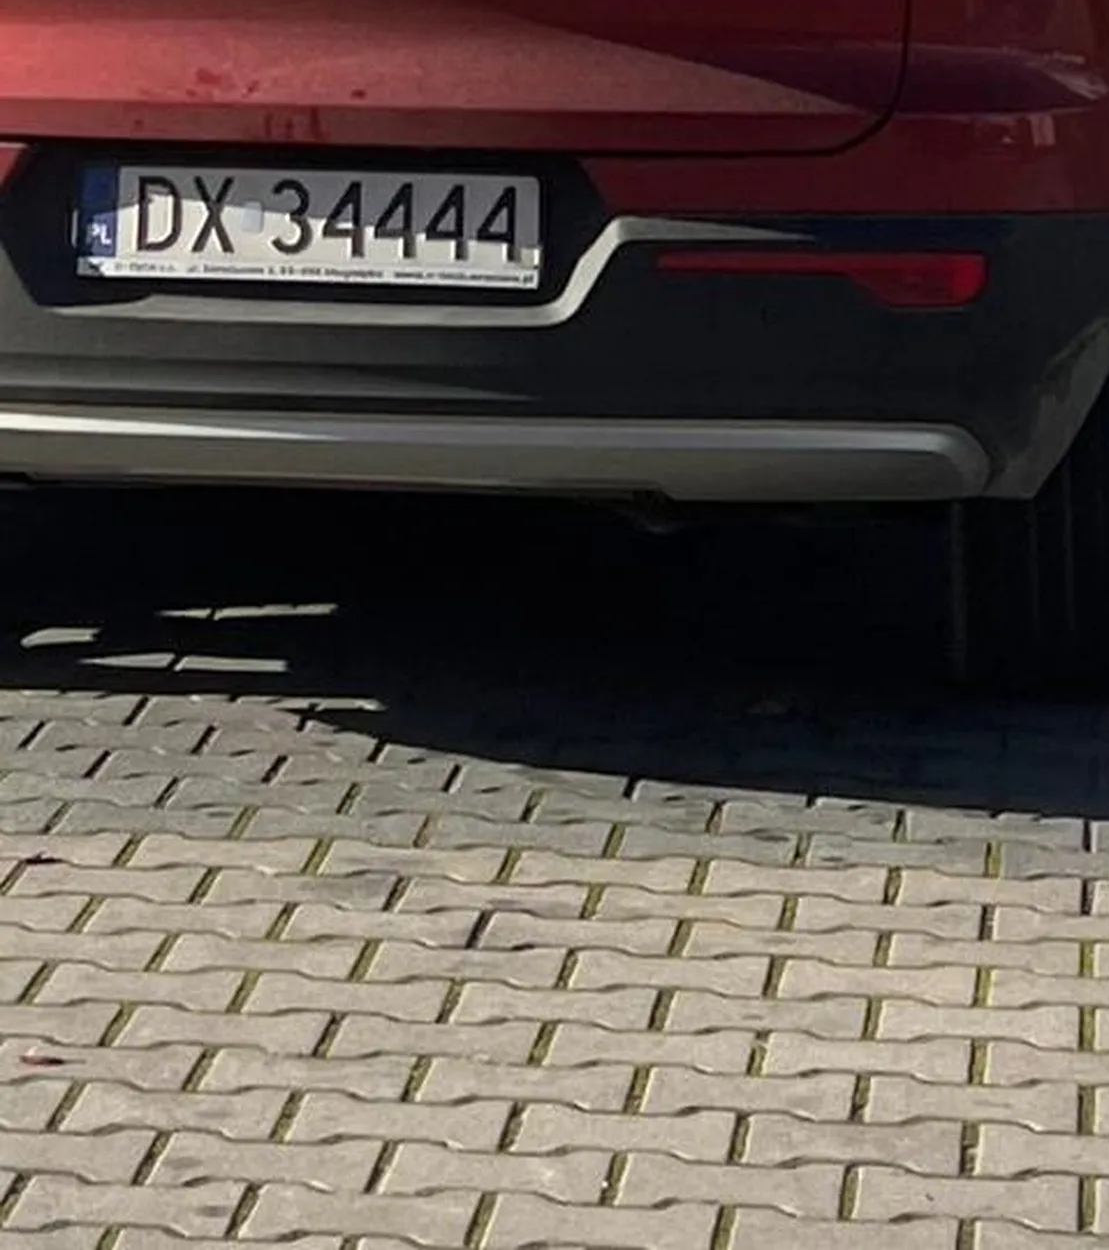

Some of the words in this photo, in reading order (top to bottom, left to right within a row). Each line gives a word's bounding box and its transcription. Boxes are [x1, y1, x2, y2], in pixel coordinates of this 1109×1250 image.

[86, 223, 112, 245] PL
[135, 175, 235, 254] DX
[269, 178, 518, 263] 34444
